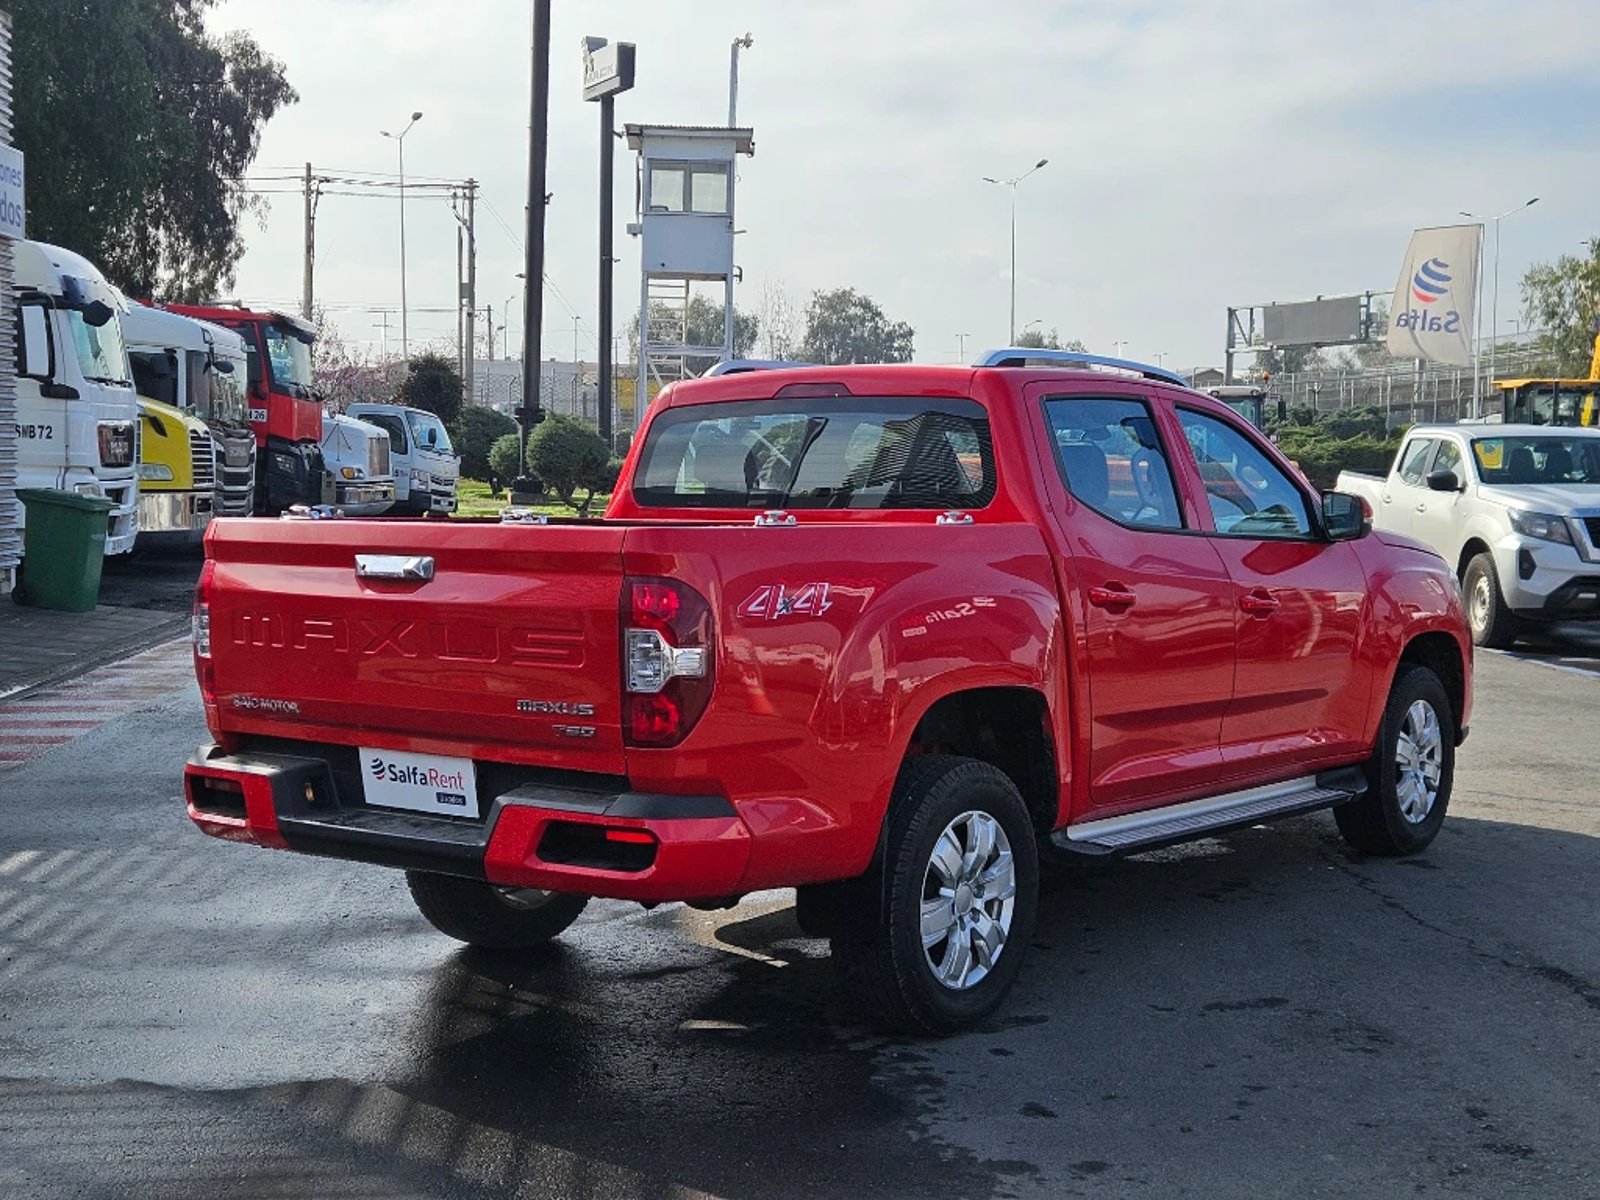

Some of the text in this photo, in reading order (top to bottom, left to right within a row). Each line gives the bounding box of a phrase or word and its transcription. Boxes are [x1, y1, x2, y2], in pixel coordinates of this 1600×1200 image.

[736, 582, 833, 620] 4x4
[232, 610, 585, 669] MAXUS
[233, 694, 300, 715] SAIC MOTOR
[516, 699, 595, 716] MAXUS
[387, 763, 465, 791] SalfaRent
